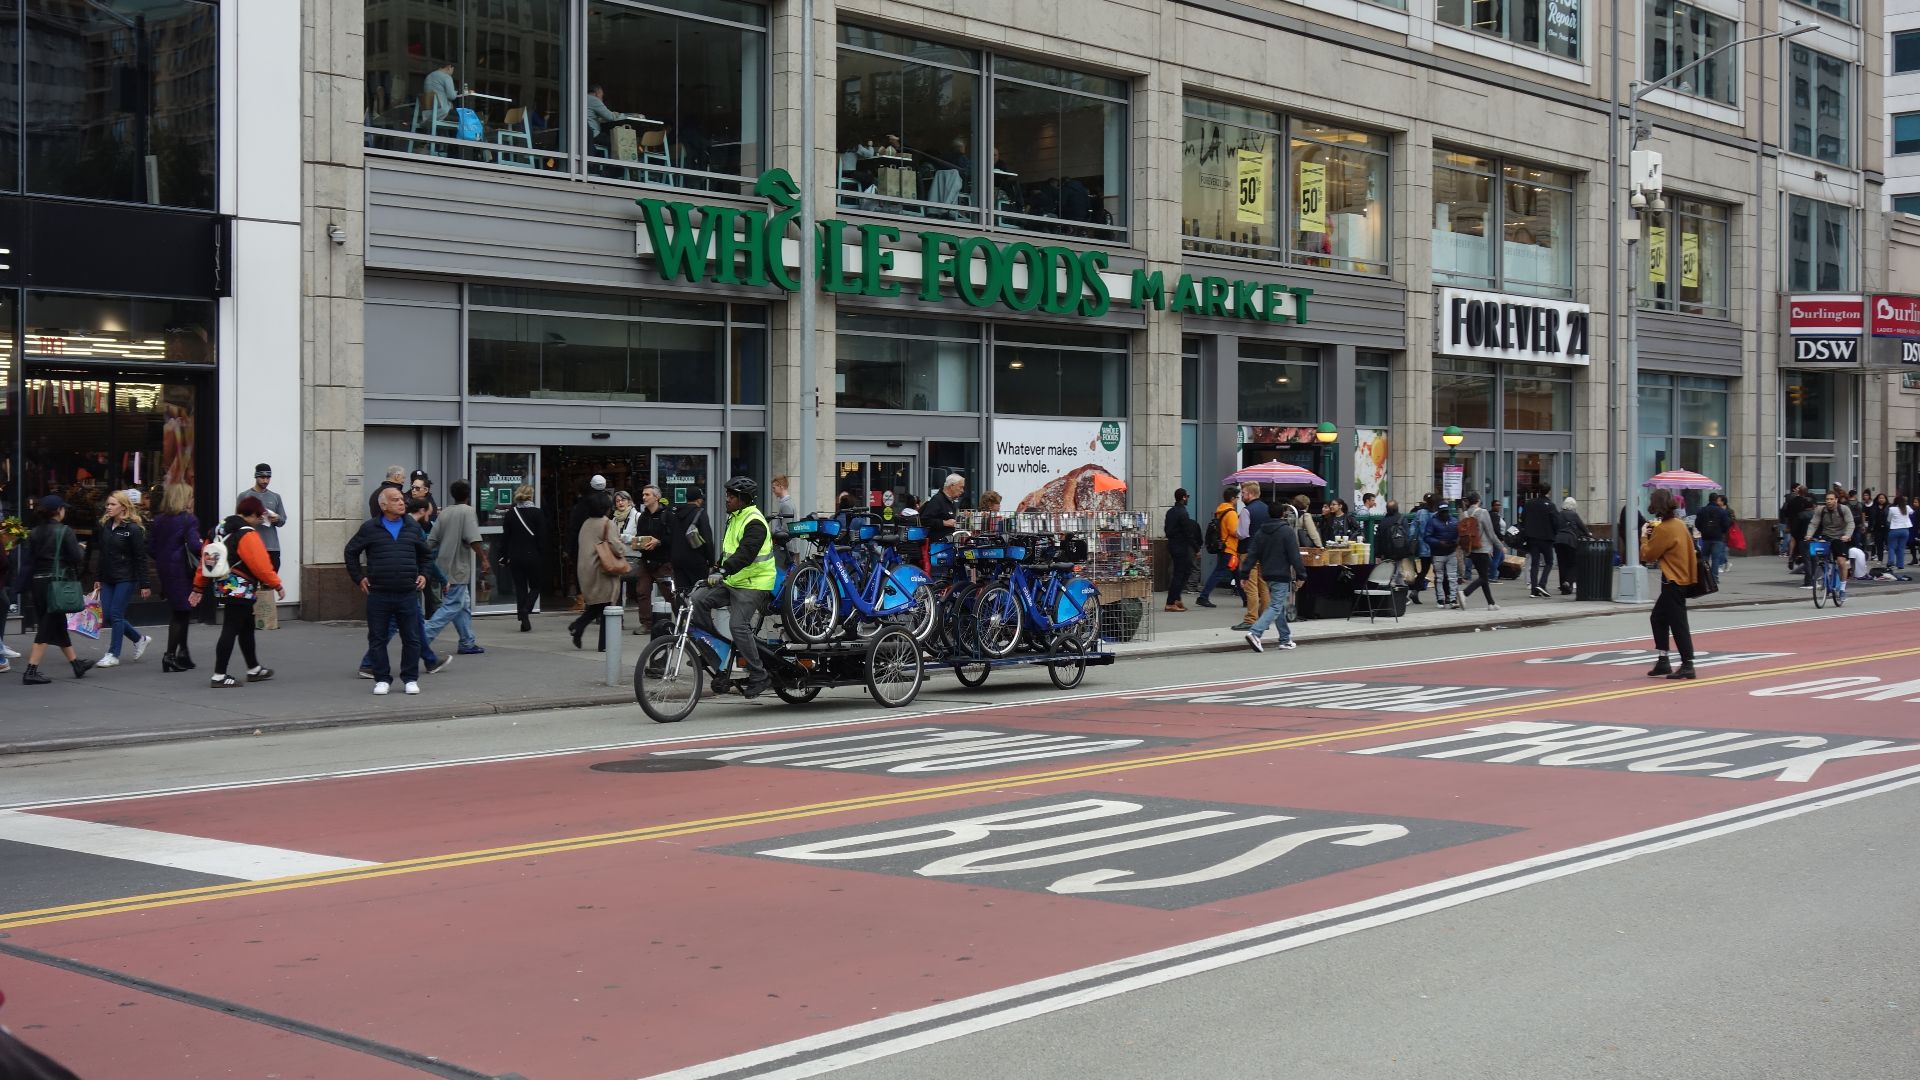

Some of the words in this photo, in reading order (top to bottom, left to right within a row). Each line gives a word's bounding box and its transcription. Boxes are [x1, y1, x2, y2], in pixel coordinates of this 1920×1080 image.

[1548, 2, 1577, 29] Repair
[636, 198, 900, 298] WHOLE
[918, 231, 1110, 318] FOODS
[1130, 268, 1314, 325] MARKET
[1451, 297, 1560, 353] FOREVER
[1566, 310, 1589, 355] 21
[1792, 307, 1861, 322] Burlington
[1797, 340, 1855, 360] DSW
[997, 442, 1045, 456] Whatever
[1047, 444, 1078, 457] makes
[997, 463, 1015, 476] you
[1017, 459, 1050, 473] whole.
[1348, 721, 1920, 783] TRUCK
[755, 798, 1410, 895] BUS
